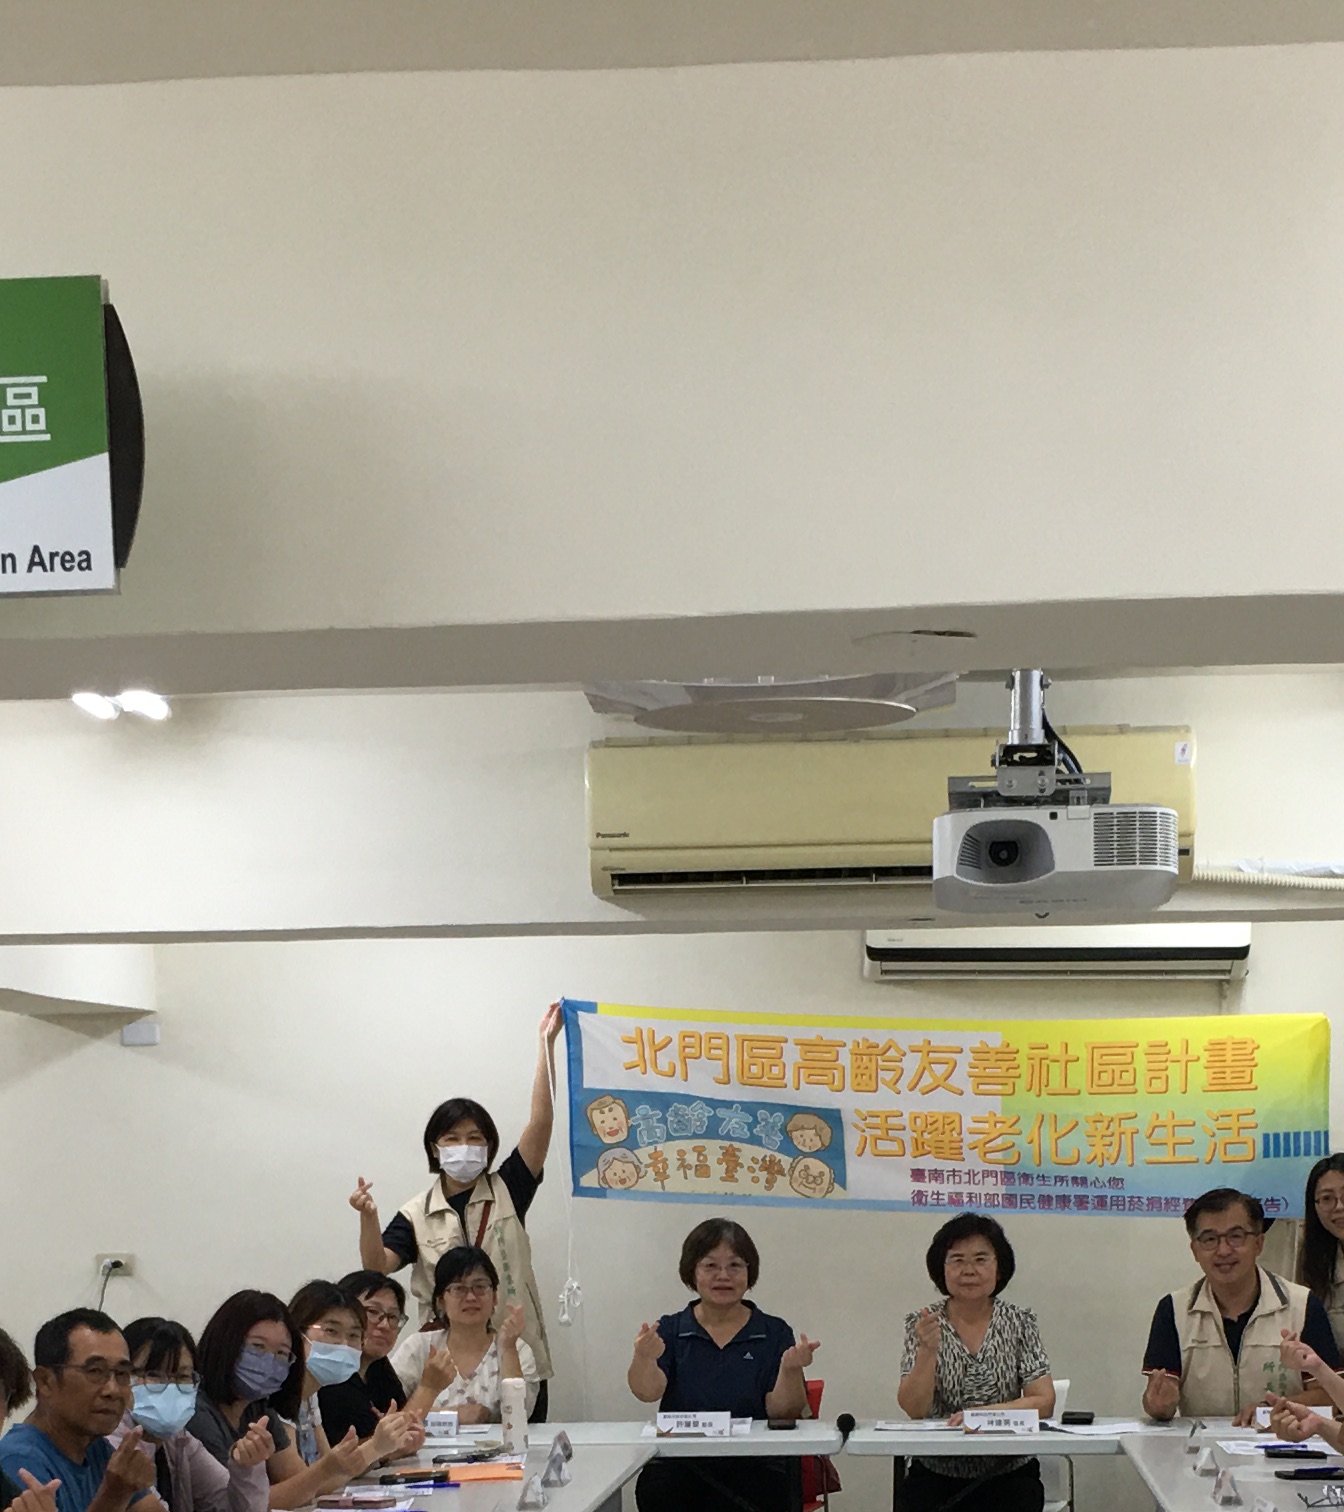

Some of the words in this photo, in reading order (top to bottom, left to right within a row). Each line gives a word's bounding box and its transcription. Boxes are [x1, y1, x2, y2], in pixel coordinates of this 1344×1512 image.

[26, 544, 93, 573] Area
[621, 1027, 1260, 1097] 北門區高齡友善社區計畫
[631, 1100, 785, 1150] 高齡友善
[852, 1107, 1259, 1167] 活躍老化新生活
[909, 1167, 1125, 1191] 臺南市北門區衛生所關心您
